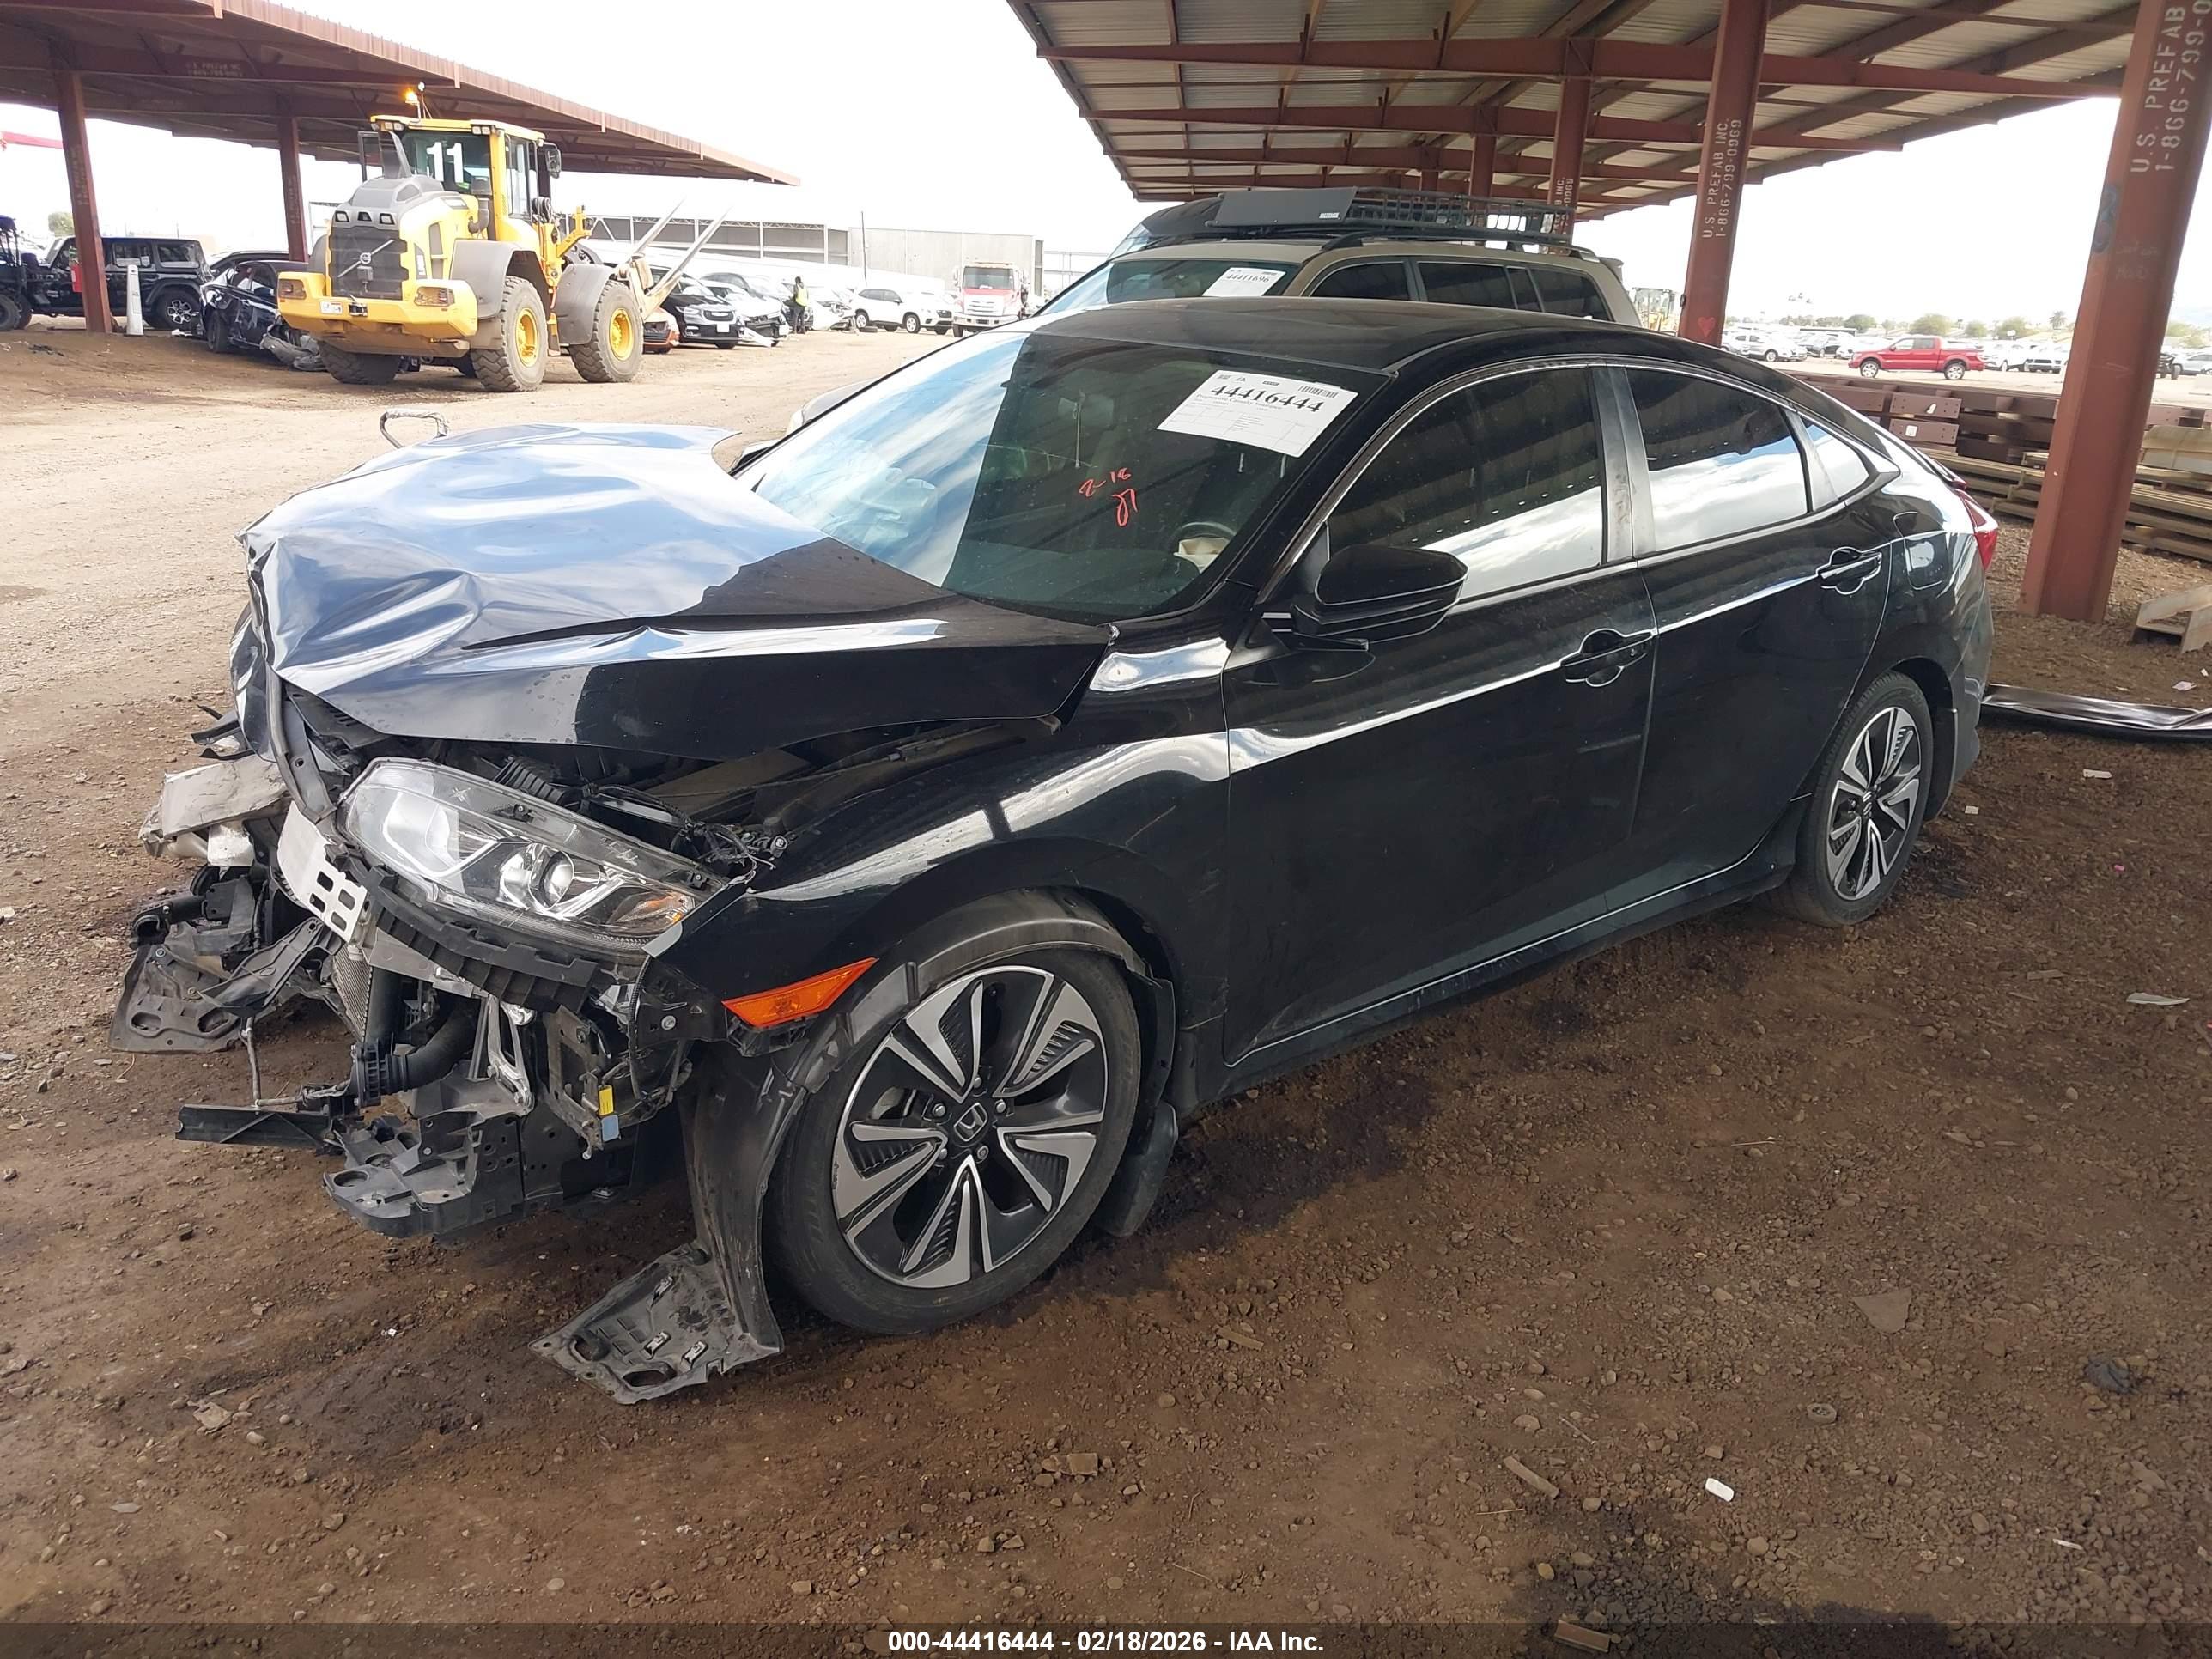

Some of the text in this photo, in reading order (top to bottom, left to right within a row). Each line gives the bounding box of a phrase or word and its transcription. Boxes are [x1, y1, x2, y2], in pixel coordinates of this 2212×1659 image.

[2144, 6, 2185, 109] PREFAB
[426, 141, 464, 184] 11
[1707, 151, 1723, 205] PREFAB
[1715, 118, 1729, 144] INC.
[1715, 118, 1742, 238] 1-866-799-0969
[1211, 385, 1325, 413] 44416444
